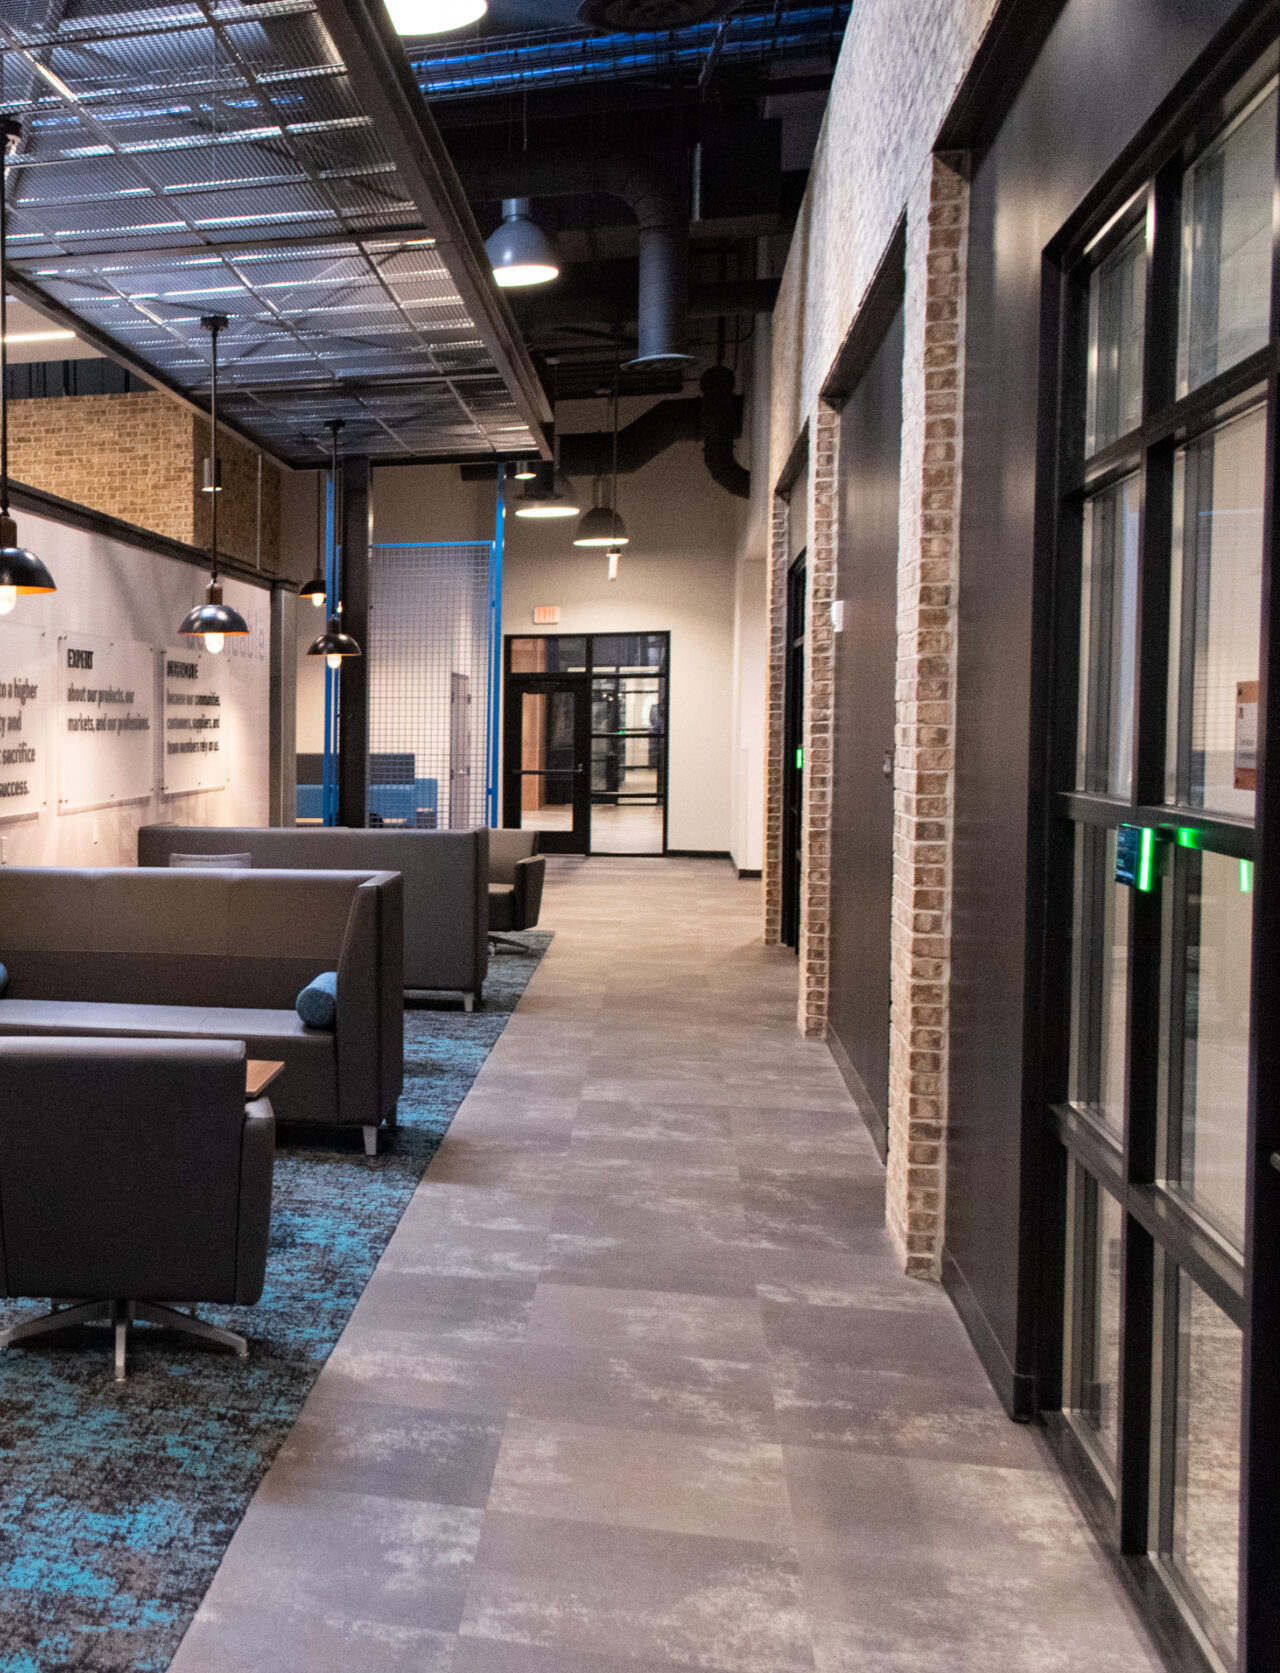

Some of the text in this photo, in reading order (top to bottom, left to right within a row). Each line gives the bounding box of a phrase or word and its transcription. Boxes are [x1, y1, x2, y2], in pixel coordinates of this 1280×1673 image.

[67, 648, 94, 670] EXPERT
[7, 683, 13, 699] a
[14, 678, 38, 705] higher
[67, 682, 86, 702] about
[87, 689, 97, 703] our
[7, 711, 22, 732] and
[96, 712, 107, 731] and
[2, 743, 36, 764] sacrifice
